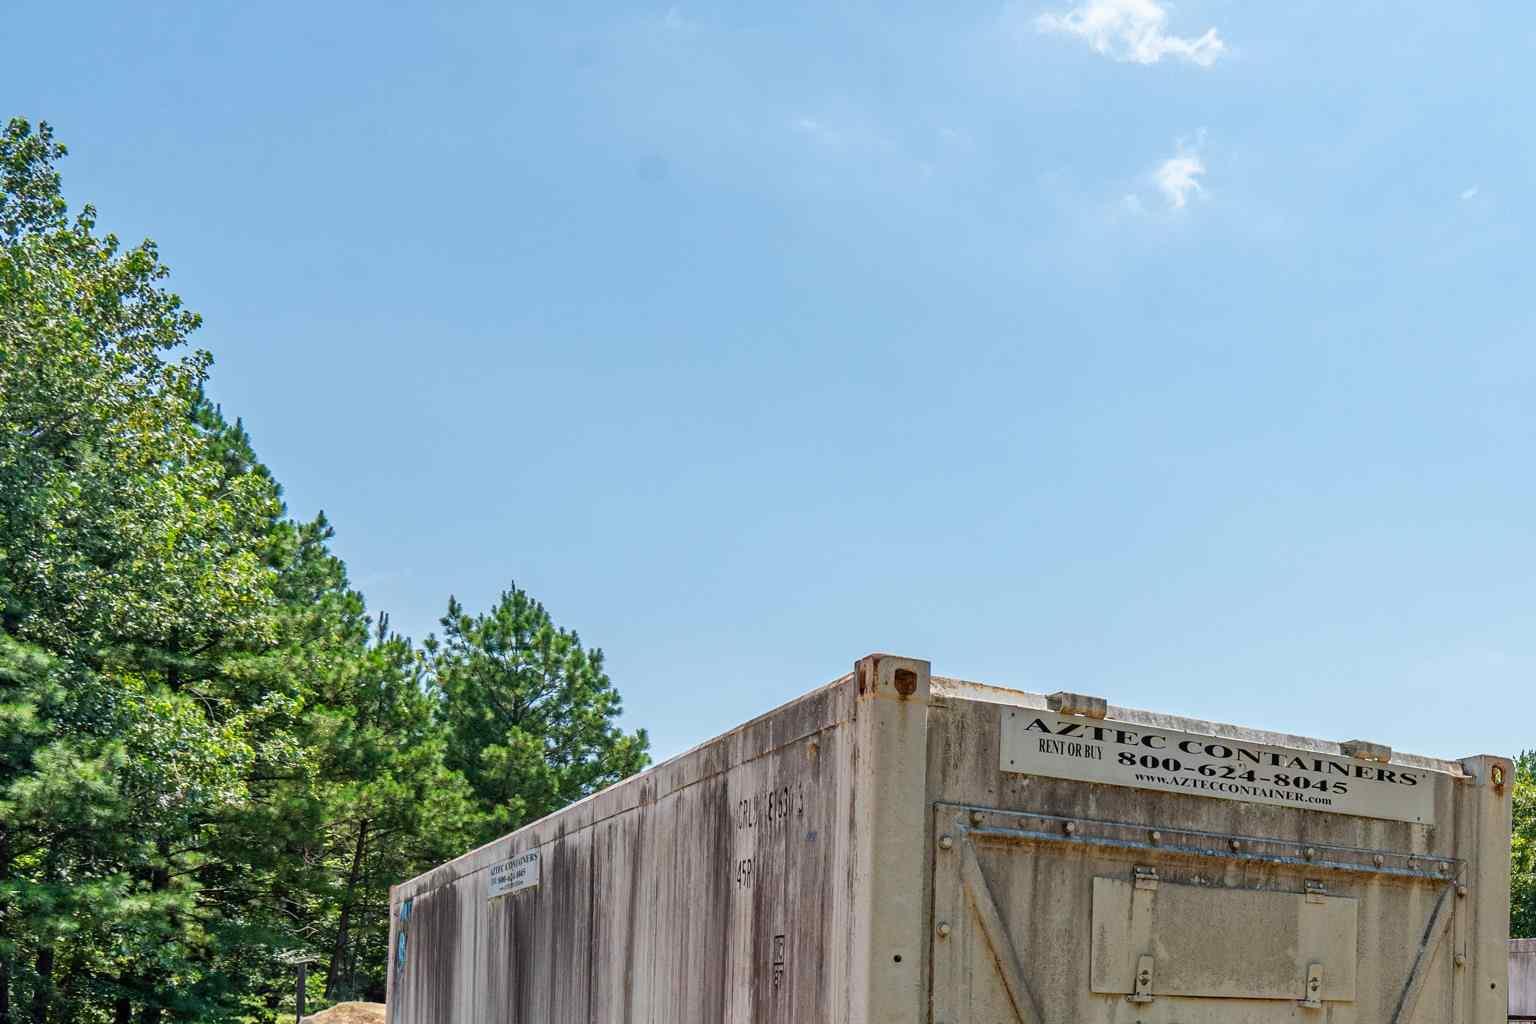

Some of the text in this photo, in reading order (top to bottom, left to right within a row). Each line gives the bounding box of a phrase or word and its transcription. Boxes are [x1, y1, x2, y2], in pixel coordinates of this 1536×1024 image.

[1023, 718, 1419, 787] AZTEC CONTAINERS
[1038, 738, 1104, 761] RENT OR BUY
[1117, 751, 1349, 796] 800-624-8045
